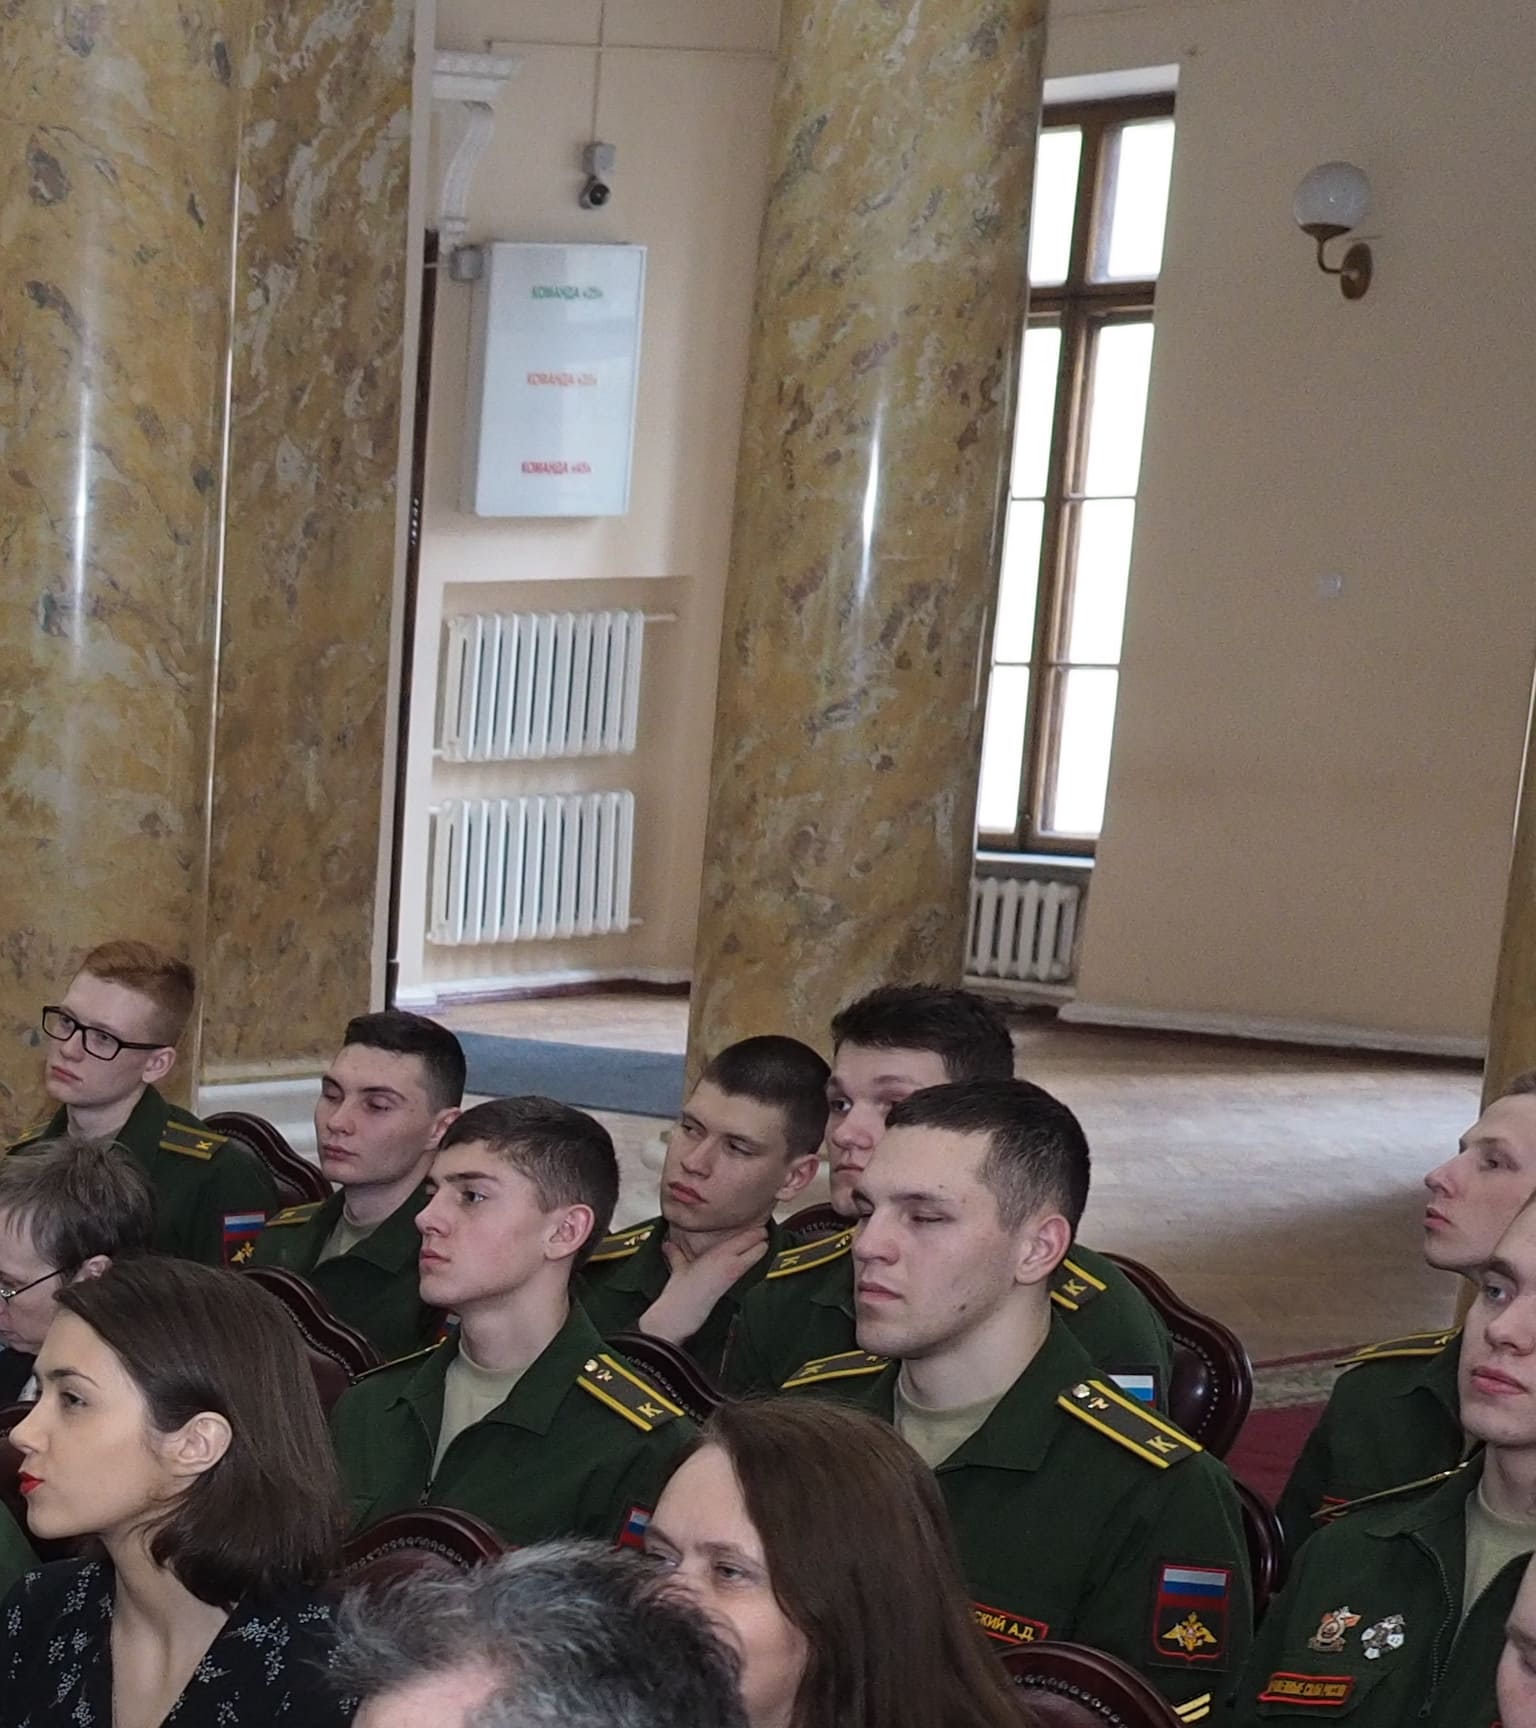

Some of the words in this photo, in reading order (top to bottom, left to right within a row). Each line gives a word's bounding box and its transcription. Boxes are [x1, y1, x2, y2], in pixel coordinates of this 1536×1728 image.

[1063, 1279, 1086, 1296] К
[638, 1402, 662, 1418] К
[1148, 1436, 1177, 1453] К
